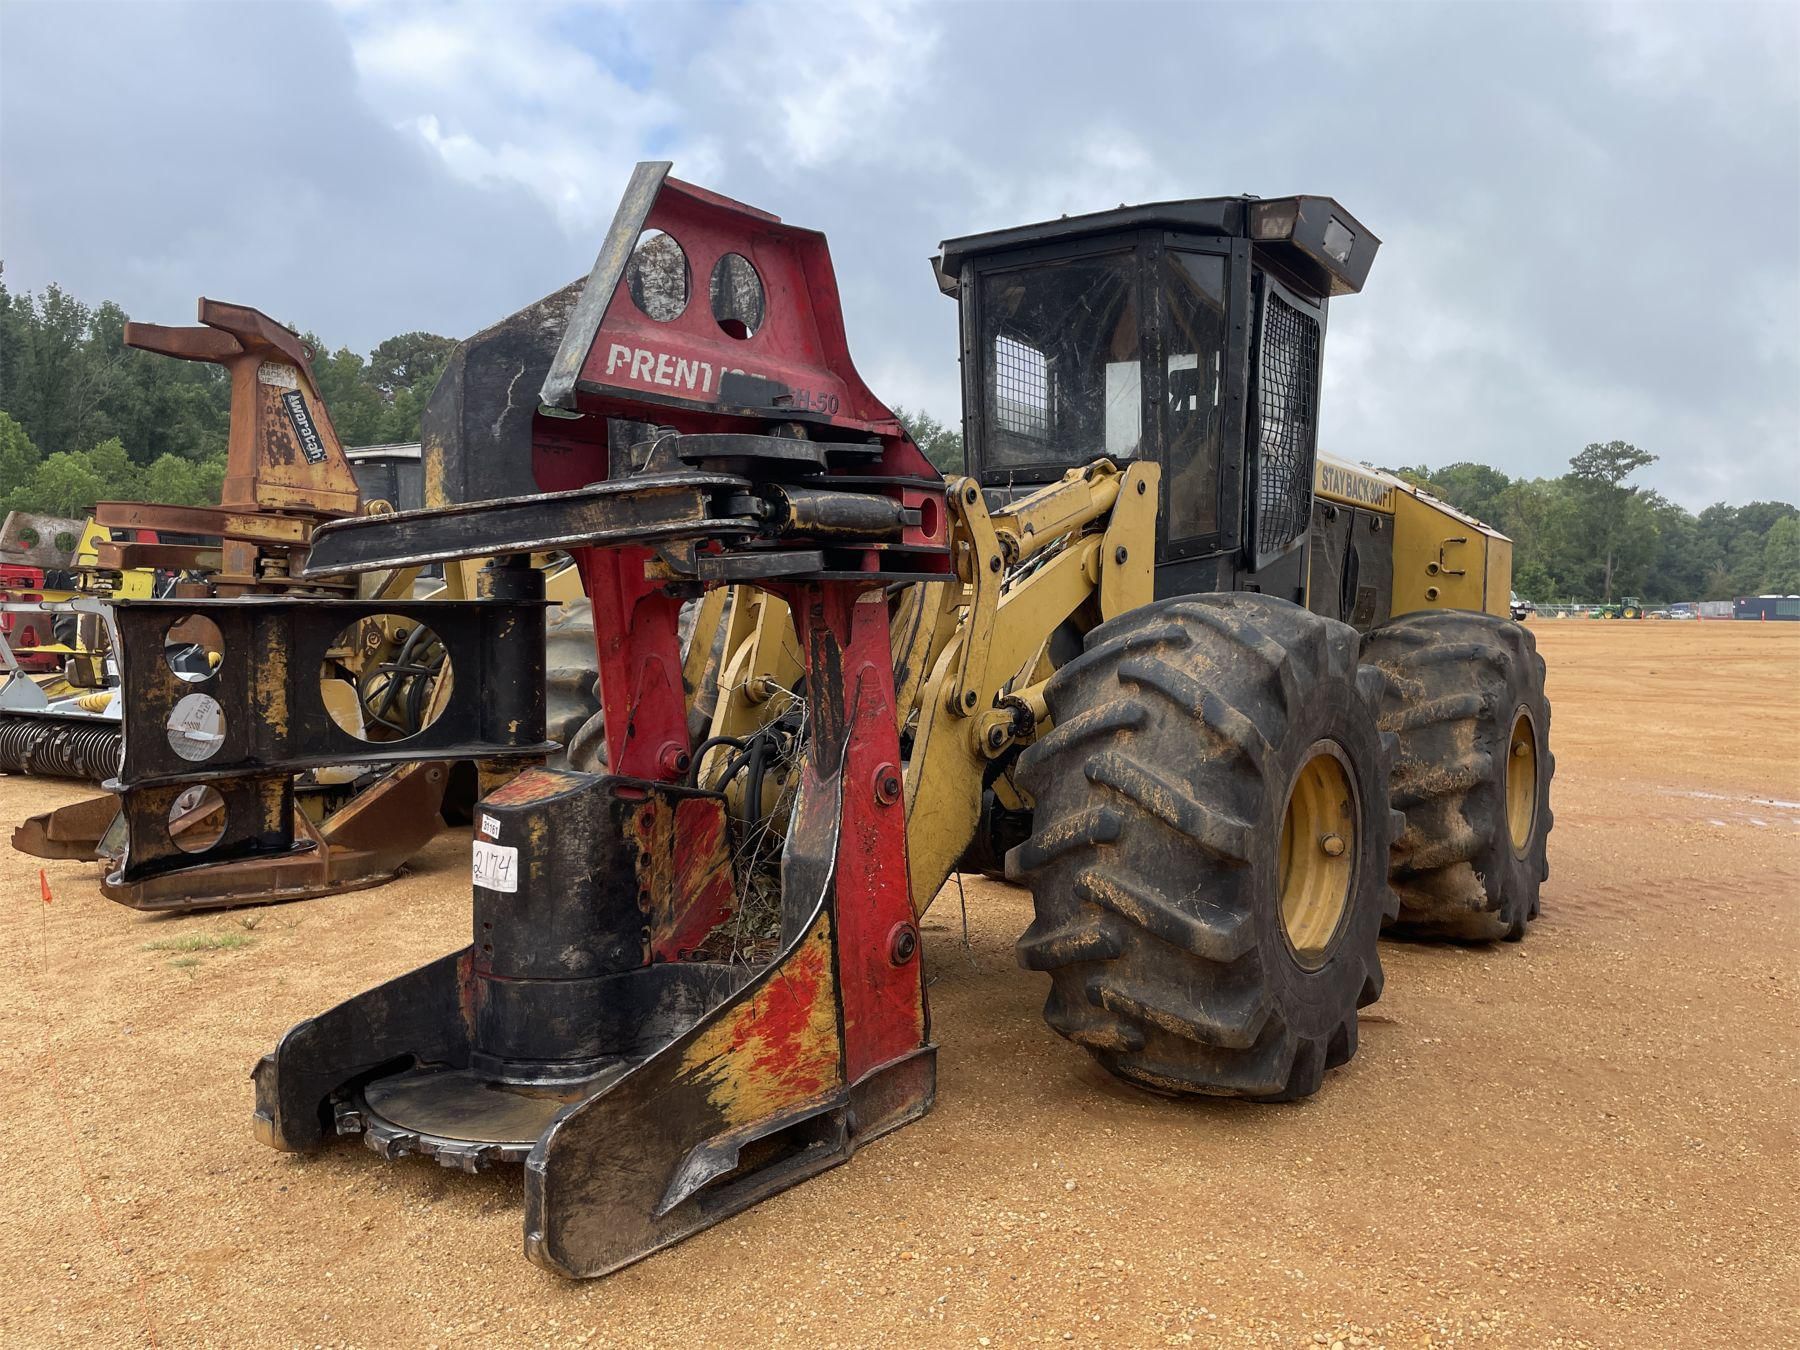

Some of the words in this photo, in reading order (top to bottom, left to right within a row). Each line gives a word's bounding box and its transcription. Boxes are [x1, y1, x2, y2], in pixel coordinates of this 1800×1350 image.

[1322, 464, 1345, 496] STAY
[1346, 473, 1369, 502] BACK
[474, 850, 512, 881] 2174
